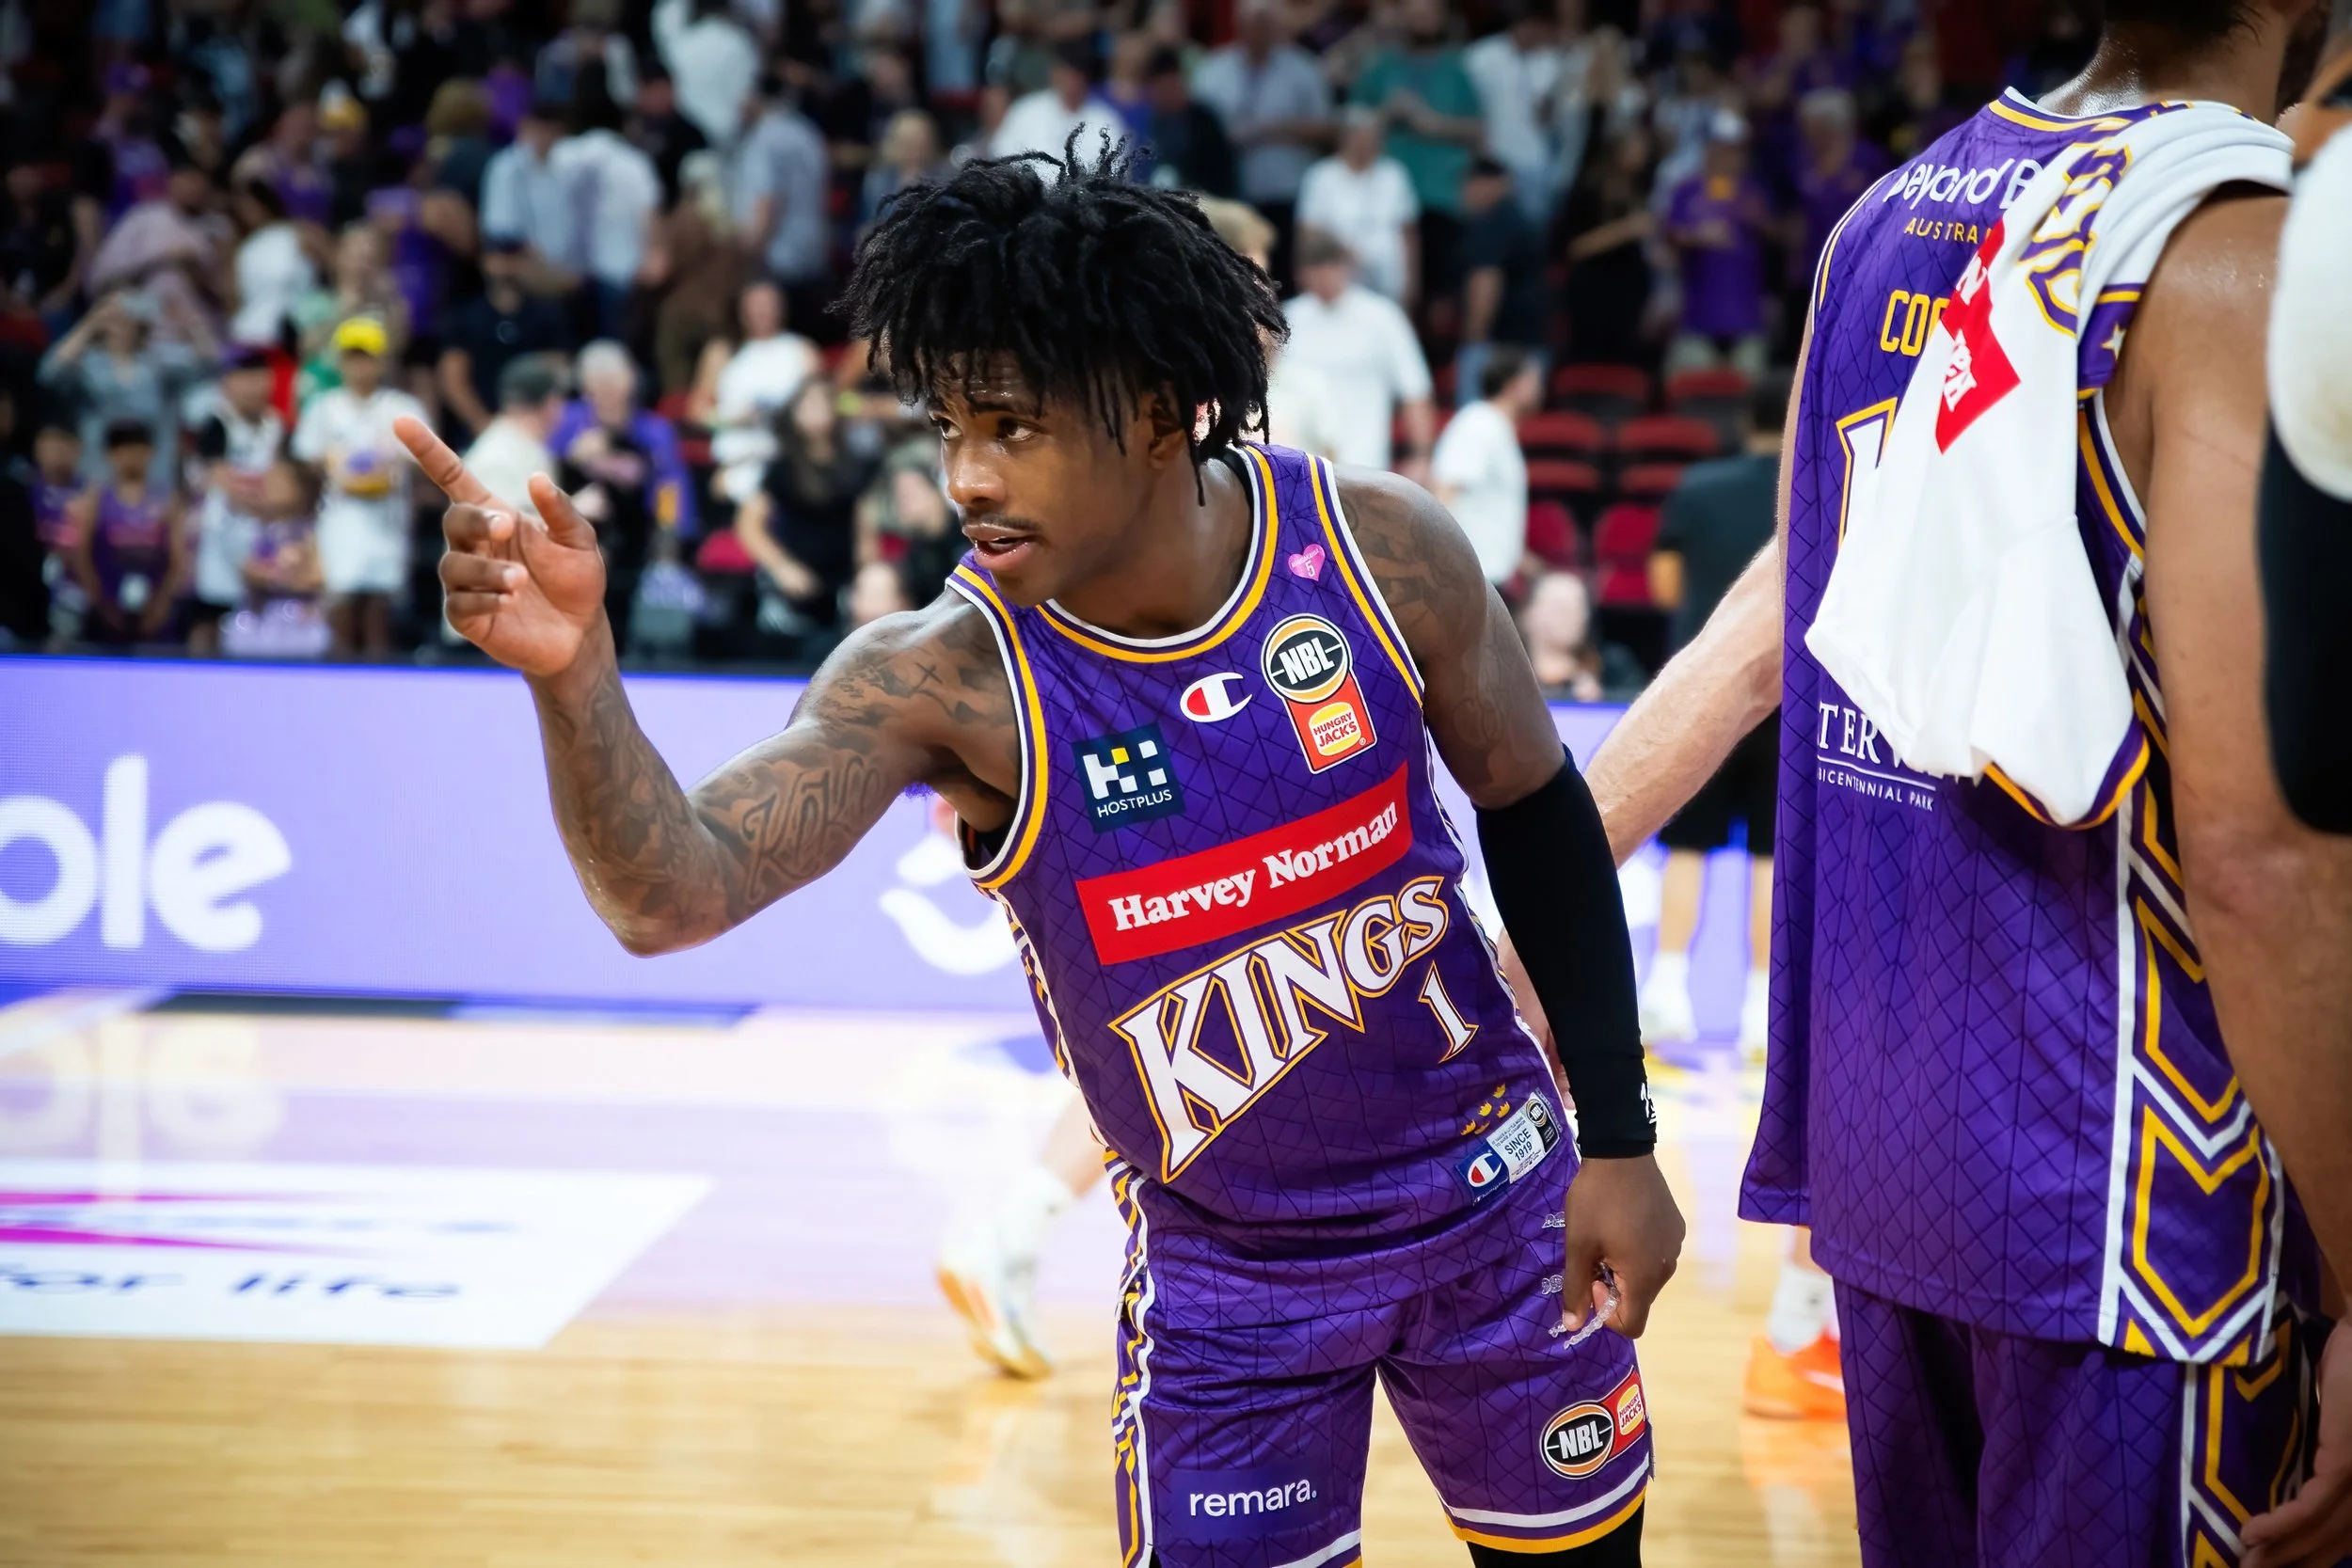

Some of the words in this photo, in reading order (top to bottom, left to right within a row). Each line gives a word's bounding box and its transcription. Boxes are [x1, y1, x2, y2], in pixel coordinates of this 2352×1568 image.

[1904, 217, 1992, 244] AUSTRA
[1305, 560, 1315, 578] 5
[1279, 637, 1335, 686] NBL
[1313, 712, 1352, 736] HUNGRY
[1319, 721, 1358, 748] JACK'S
[1097, 789, 1172, 818] HOSTPLUS
[1910, 791, 1933, 812] PARK
[1108, 869, 1256, 931] Harvey
[1263, 801, 1398, 888] Norman
[1418, 959, 1479, 1064] 1
[1108, 877, 1449, 1184] KINGS
[1504, 1128, 1532, 1155] SINCE
[1514, 1141, 1533, 1162] 1919
[1619, 1394, 1639, 1417] HUNGRY
[1558, 1420, 1603, 1460] NBL
[1190, 1479, 1317, 1516] remara.
